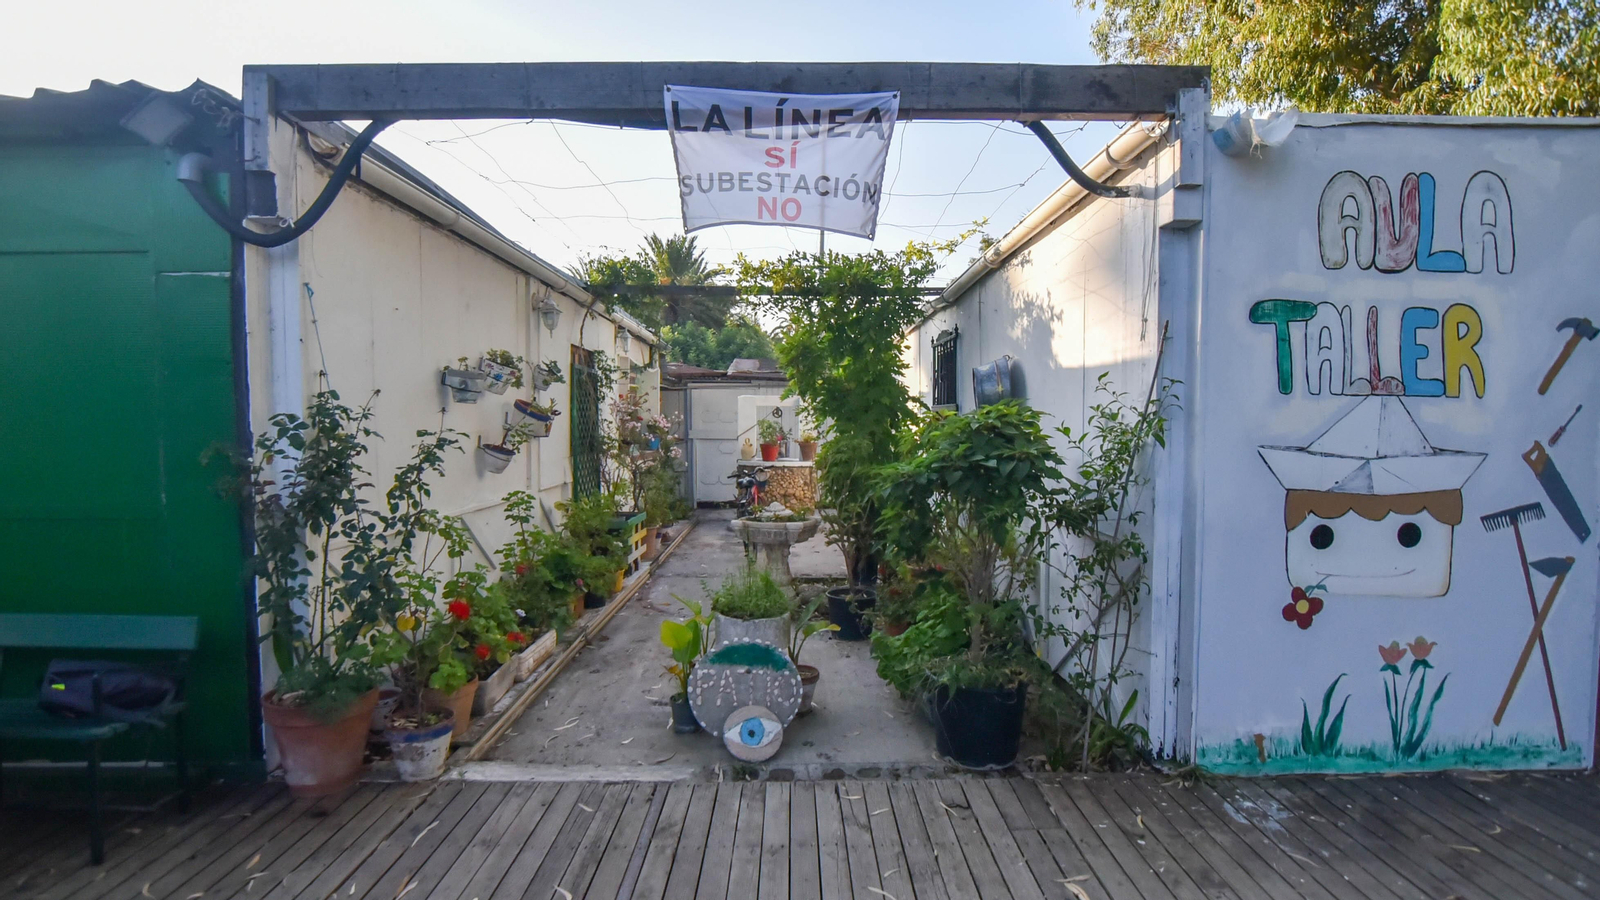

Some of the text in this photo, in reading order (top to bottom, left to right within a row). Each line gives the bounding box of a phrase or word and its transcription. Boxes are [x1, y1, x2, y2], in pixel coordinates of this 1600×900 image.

[671, 98, 886, 141] LA LÍNEA
[764, 141, 801, 169] SÍ
[681, 172, 878, 205] SUBESTACIÓN
[757, 196, 802, 222] NO
[1318, 170, 1516, 274] AULA
[1249, 299, 1486, 399] TALLER
[696, 669, 797, 707] PATIO
